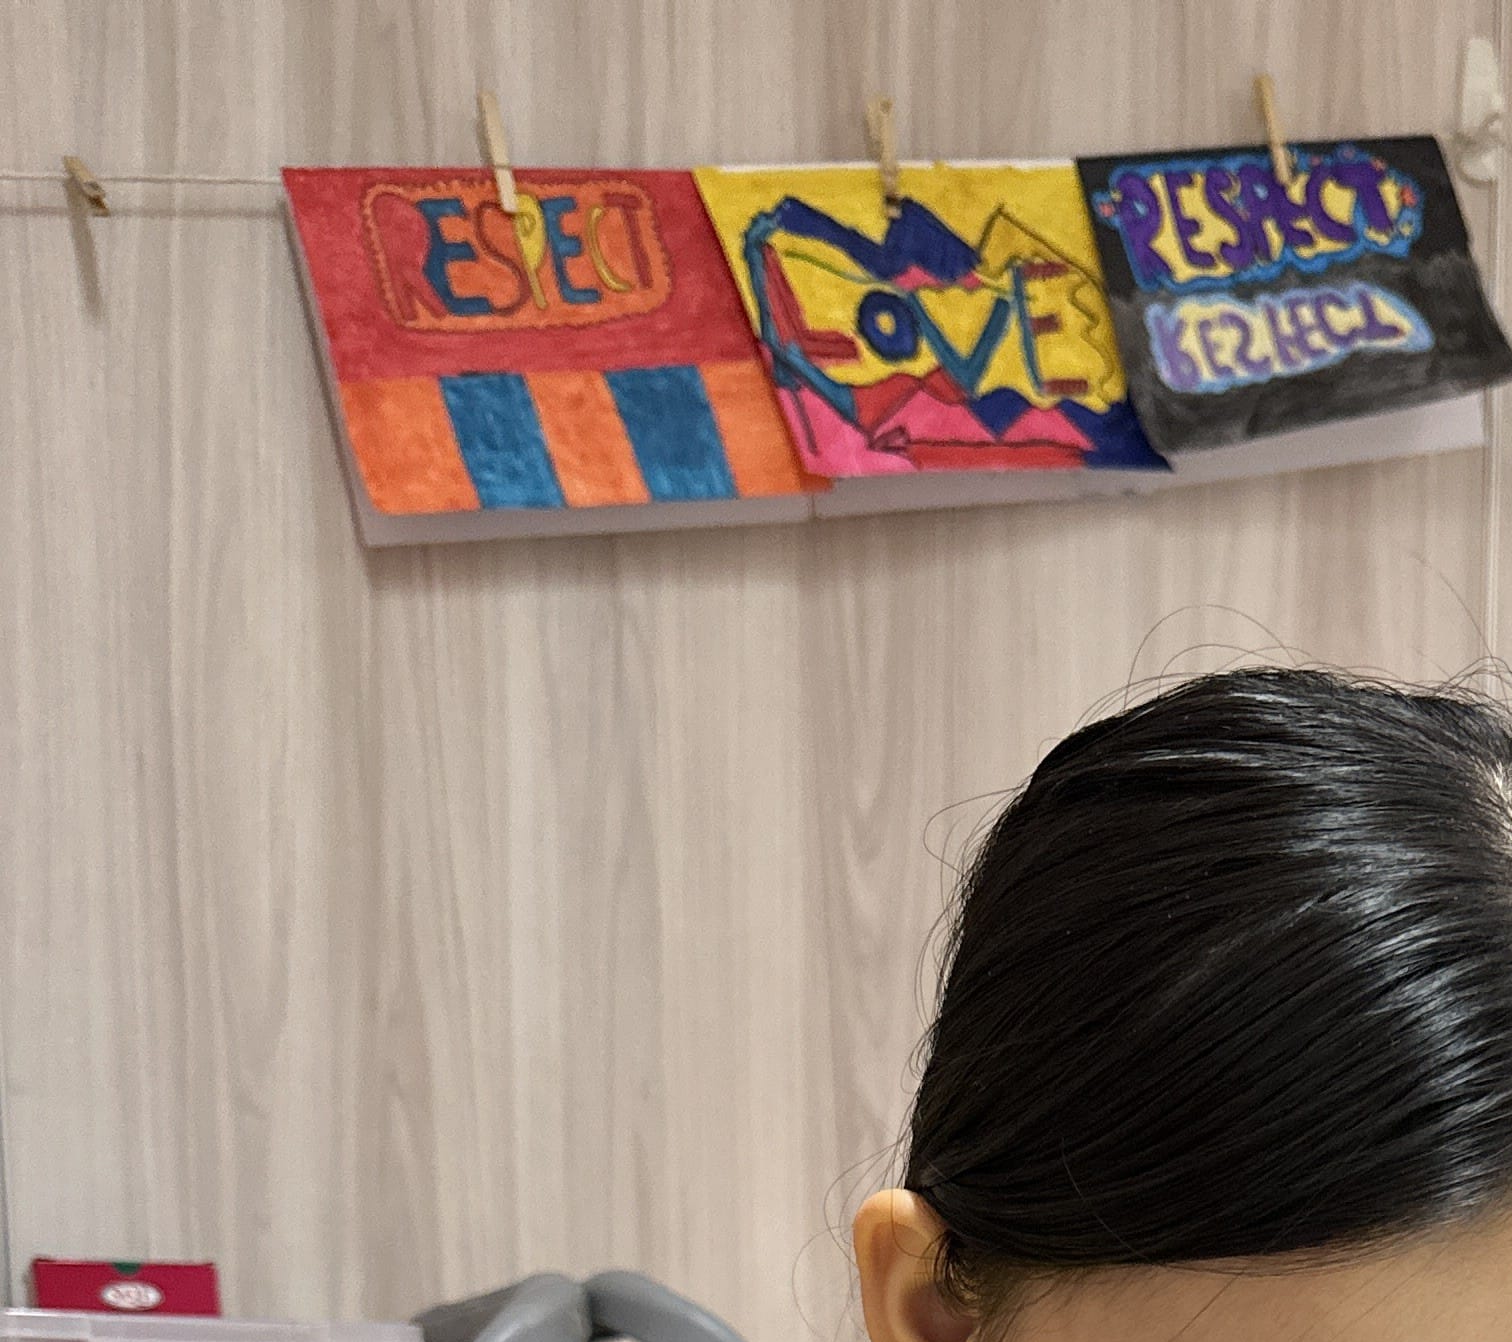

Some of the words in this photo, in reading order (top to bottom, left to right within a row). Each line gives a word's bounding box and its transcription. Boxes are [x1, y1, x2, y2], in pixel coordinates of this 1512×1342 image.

[369, 190, 655, 318] RESPECT
[1116, 158, 1394, 282] RESPECT
[762, 243, 1092, 398] LOVE
